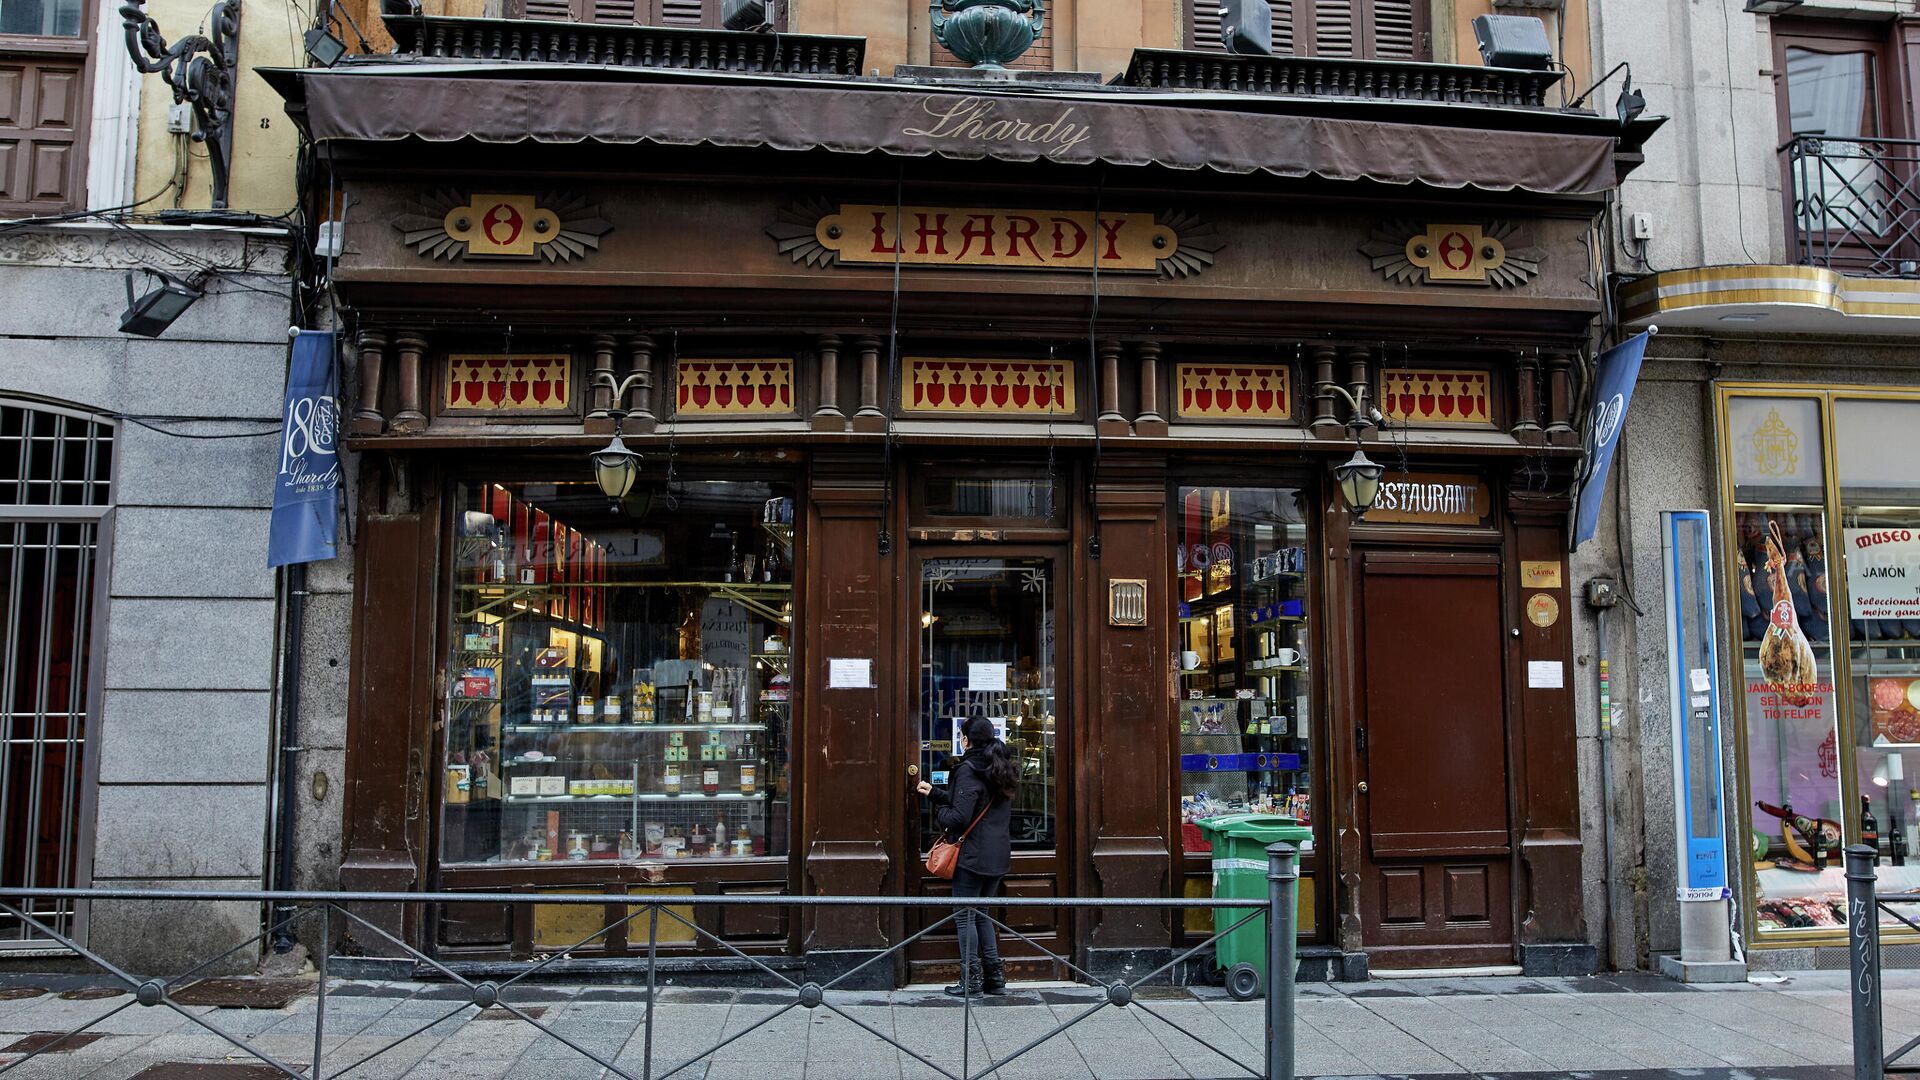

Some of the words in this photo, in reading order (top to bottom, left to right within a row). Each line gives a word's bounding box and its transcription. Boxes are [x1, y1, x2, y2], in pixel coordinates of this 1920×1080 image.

[260, 117, 270, 129] 8
[903, 94, 1091, 158] Lhardy
[871, 212, 1127, 262] LHARDY
[285, 457, 340, 490] Lhardy
[1371, 481, 1478, 514] ESTAURANT
[1856, 530, 1911, 549] MUSEO
[1862, 564, 1906, 578] JAMÓN
[1862, 608, 1892, 616] mejor
[1787, 684, 1835, 693] BODEGA
[937, 689, 1037, 718] LHARDY
[1784, 709, 1821, 719] FELIPE
